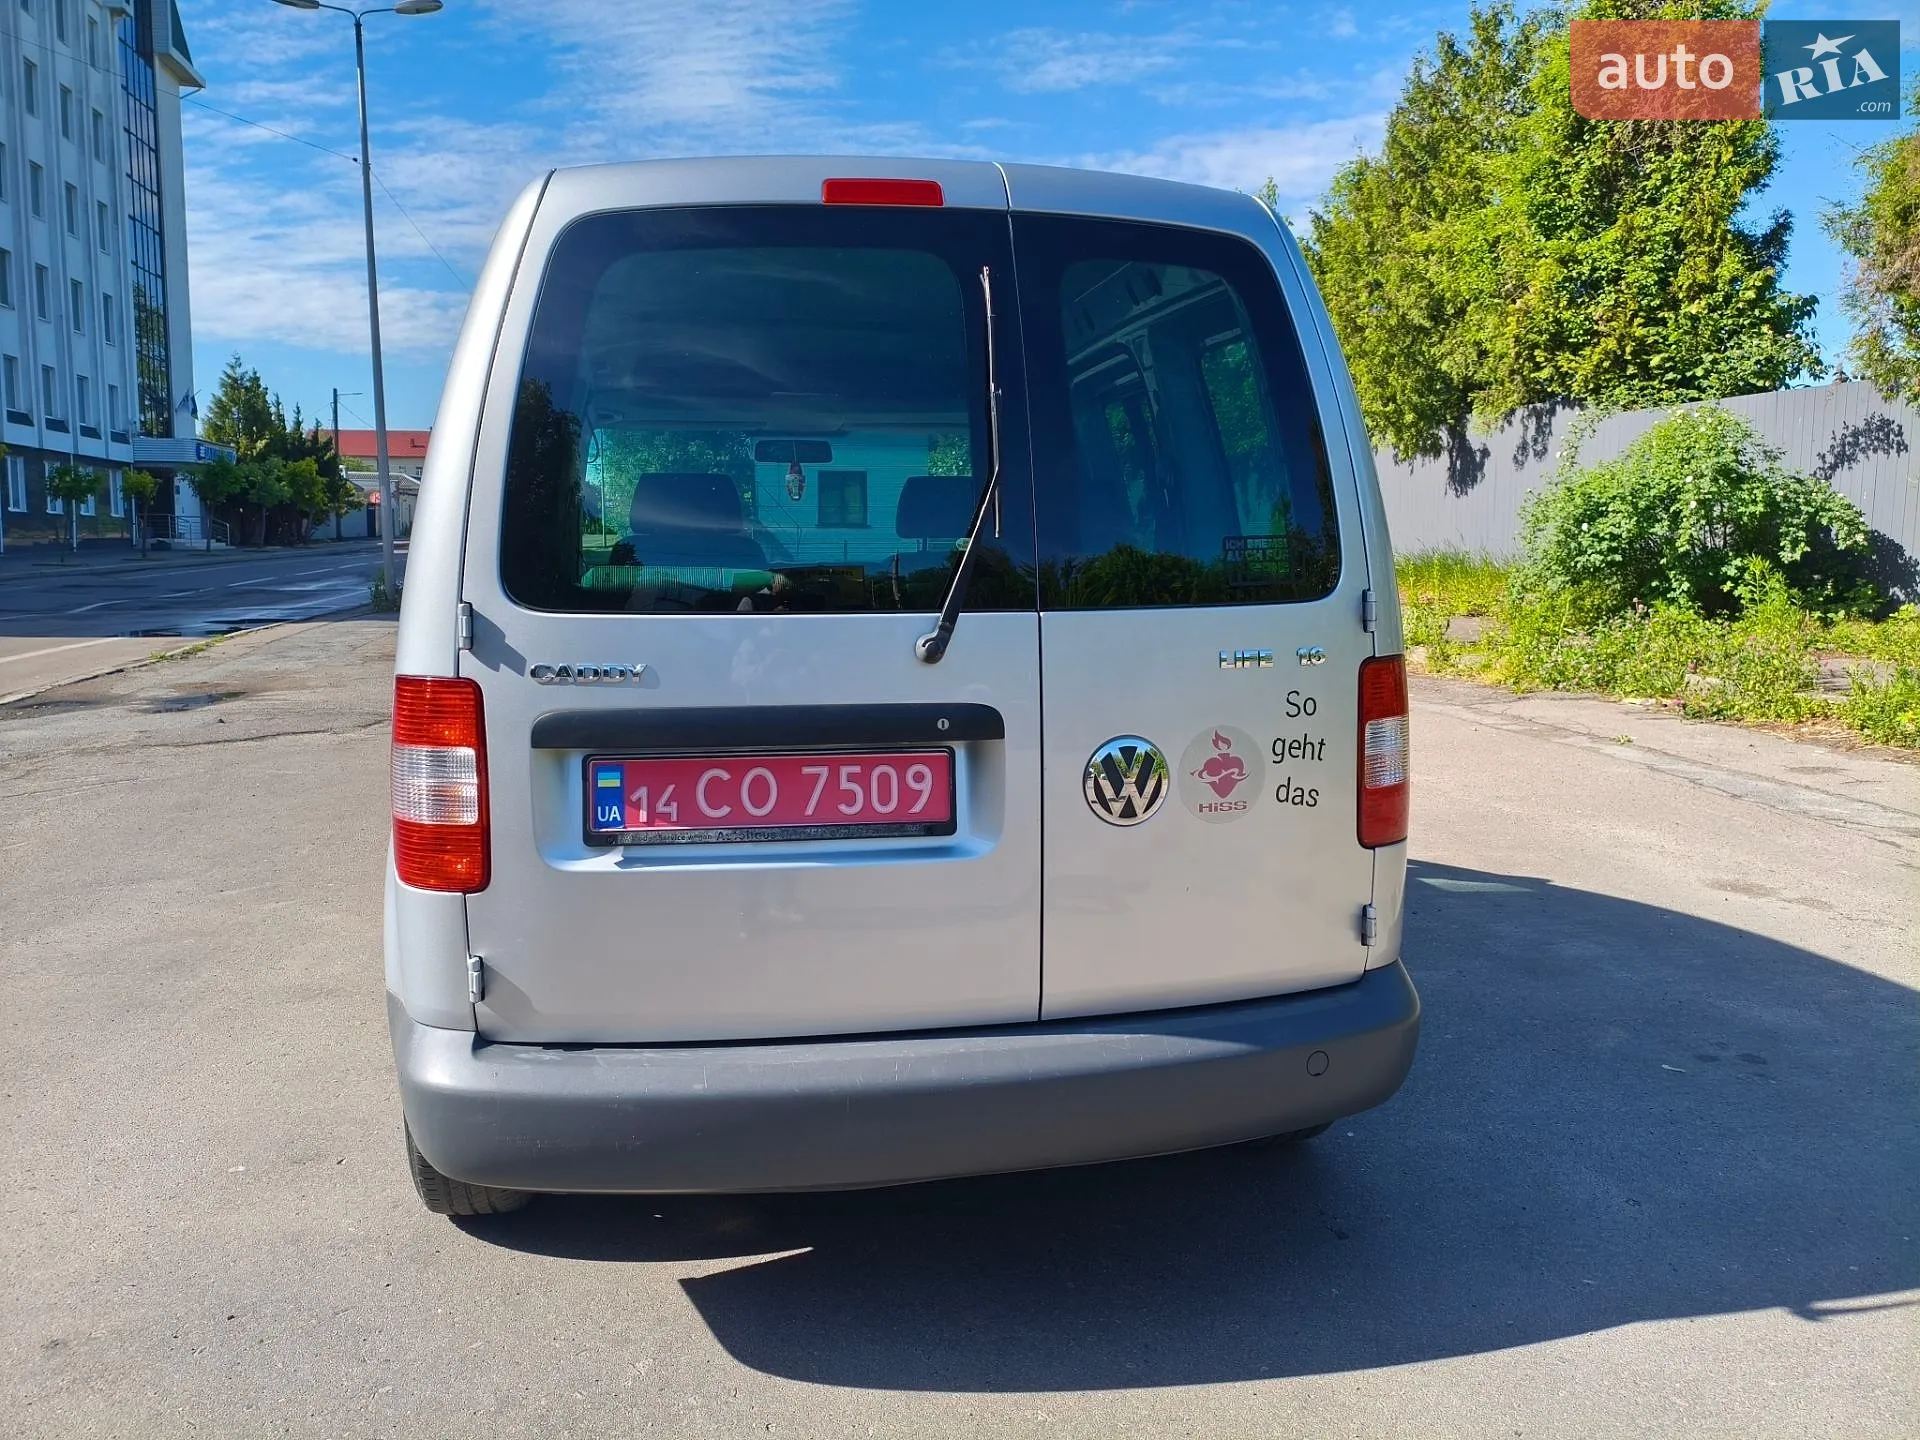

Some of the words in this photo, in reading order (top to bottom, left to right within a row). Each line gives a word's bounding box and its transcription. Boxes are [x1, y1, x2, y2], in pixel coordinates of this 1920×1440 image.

[1219, 649, 1273, 668] LIFE
[530, 663, 648, 686] CADDY
[1285, 690, 1317, 718] So
[1272, 733, 1326, 764] geht
[629, 784, 679, 823] 14
[695, 766, 778, 819] CO
[800, 763, 933, 816] 7509
[1275, 776, 1320, 807] das
[597, 805, 621, 822] UA
